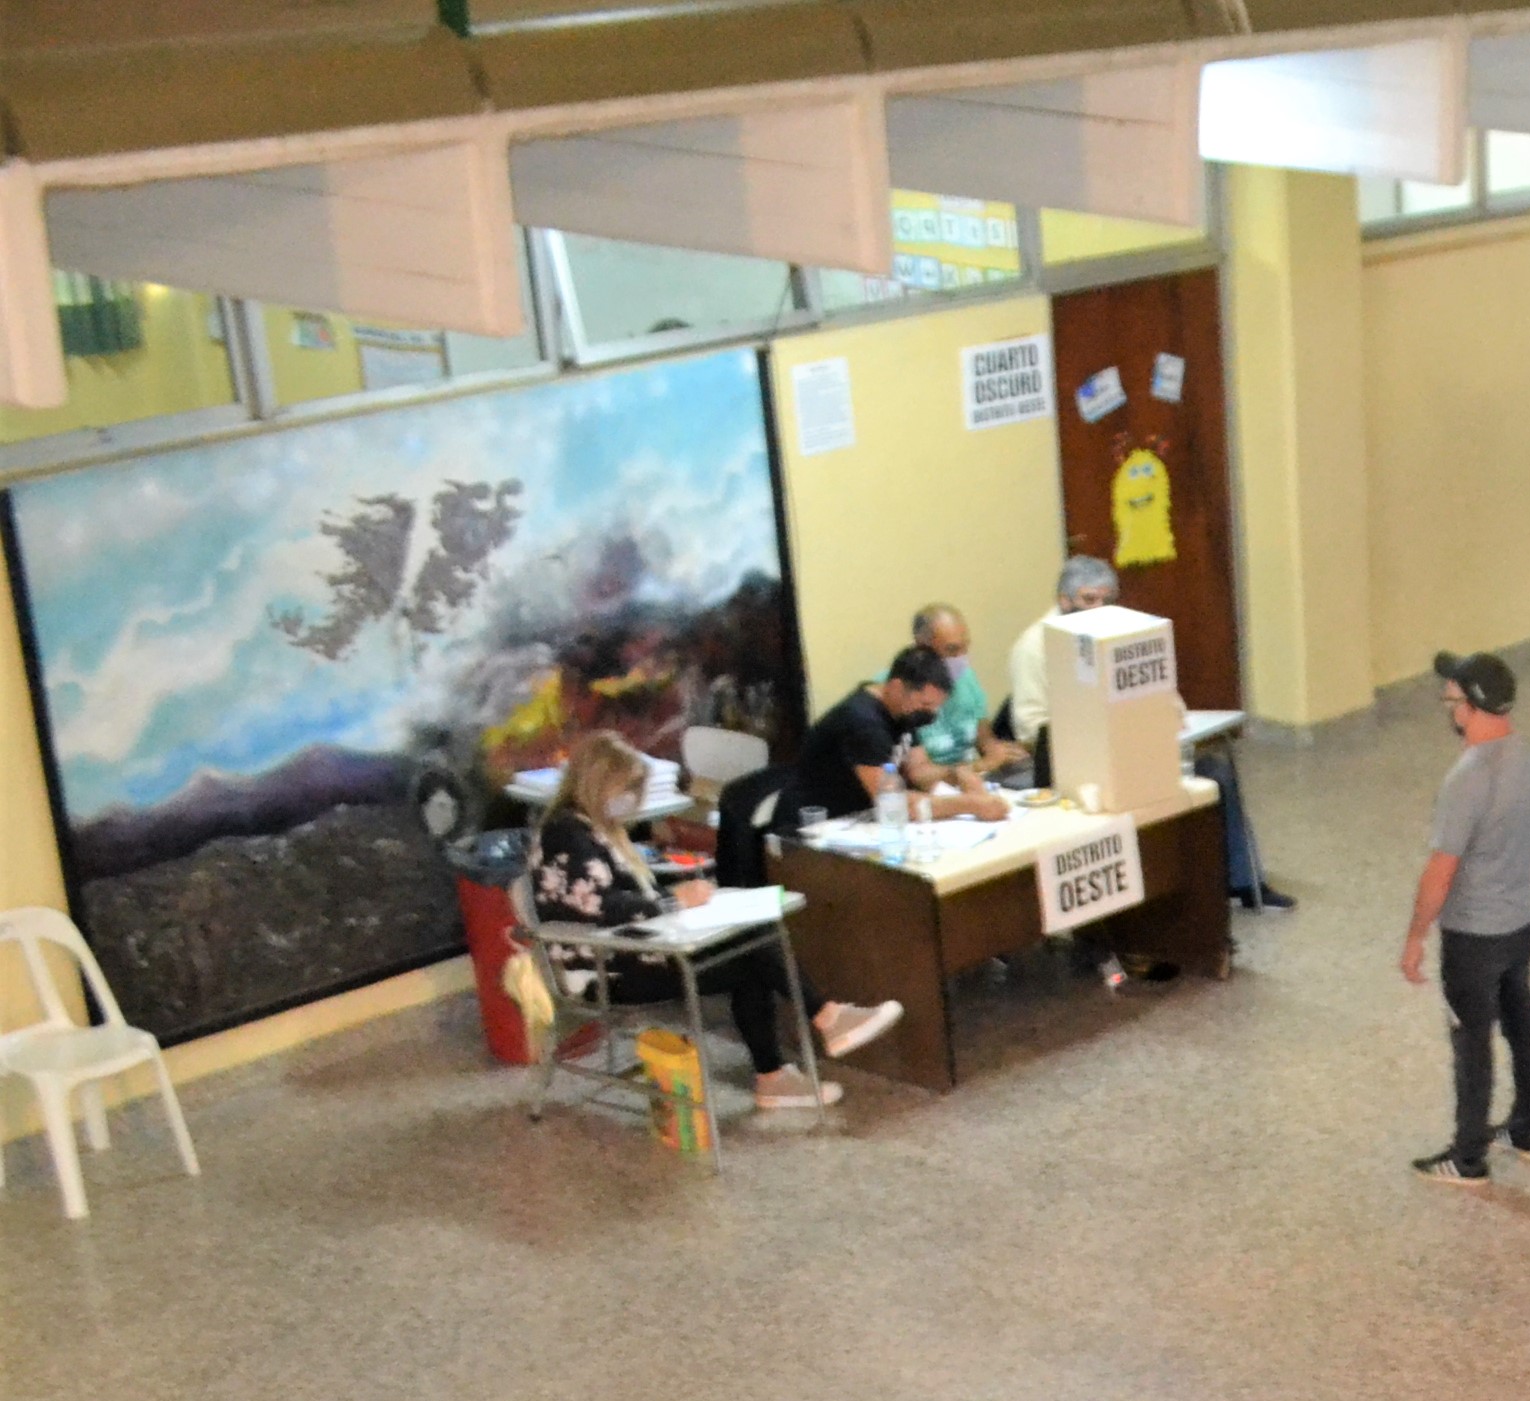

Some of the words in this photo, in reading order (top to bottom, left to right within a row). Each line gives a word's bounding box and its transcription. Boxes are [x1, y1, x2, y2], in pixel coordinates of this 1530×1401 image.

[975, 343, 1039, 377] CUARTO
[975, 369, 1042, 404] OSCURO
[1113, 637, 1167, 664] DISTRITO
[1115, 657, 1169, 690] OESTE
[1056, 834, 1123, 876] DISTRITO
[1060, 860, 1129, 913] OESTE
